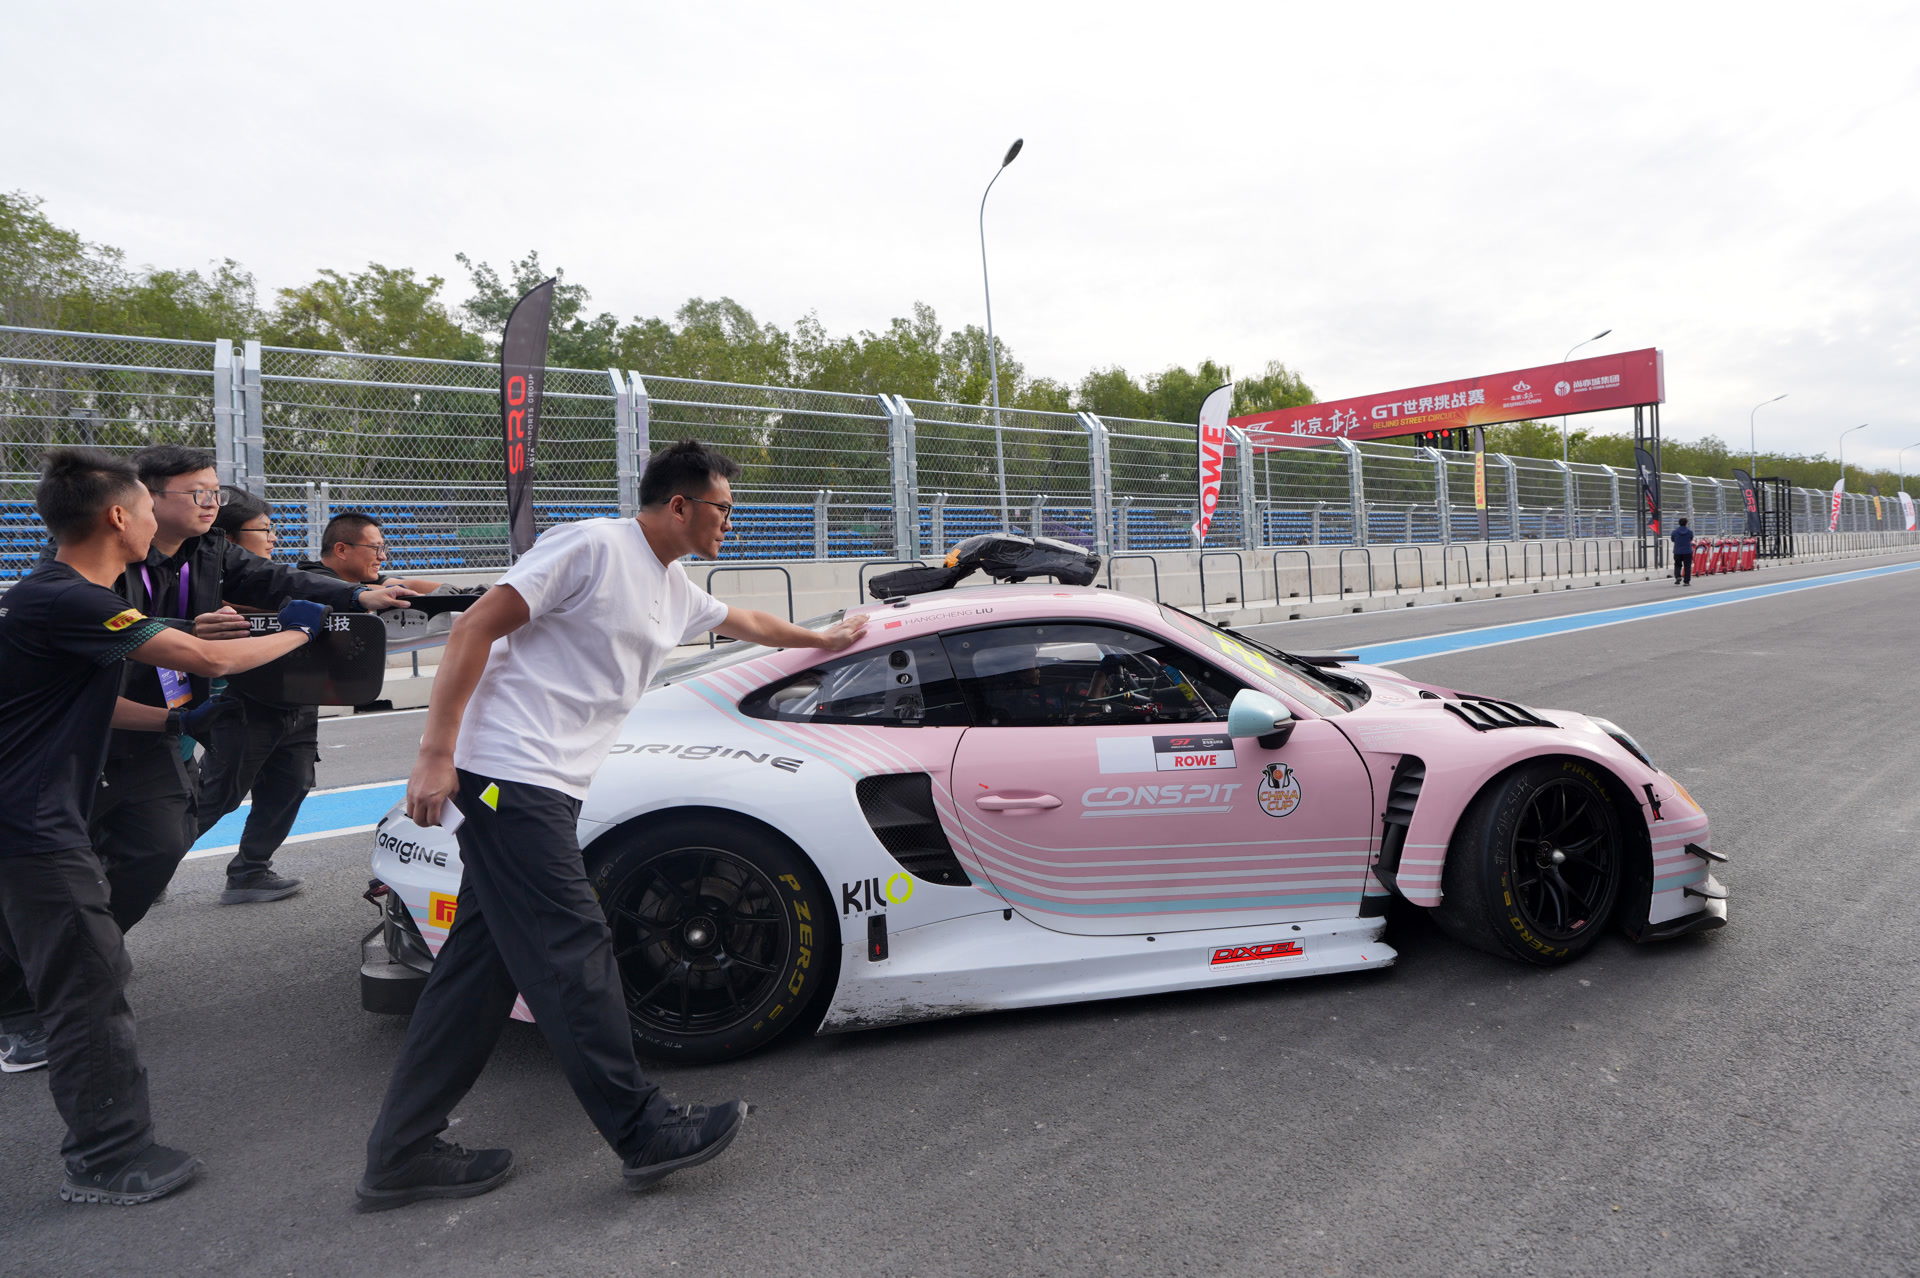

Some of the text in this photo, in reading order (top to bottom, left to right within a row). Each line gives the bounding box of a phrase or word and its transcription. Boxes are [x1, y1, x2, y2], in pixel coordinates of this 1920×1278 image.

[508, 375, 525, 475] SRO
[1372, 411, 1457, 429] BEIJING STREET CIRCUIT
[905, 607, 993, 625] HANGCHENG LIU
[1175, 755, 1217, 767] ROWE
[1563, 762, 1614, 806] PIRELL
[1081, 784, 1243, 808] CONSPIT
[1260, 790, 1298, 801] CHINA
[1267, 800, 1293, 811] CUP
[842, 872, 914, 915] KILO
[1510, 917, 1554, 955] ZERO
[788, 900, 814, 996] ZERO
[1212, 941, 1303, 961] DIXCEL
